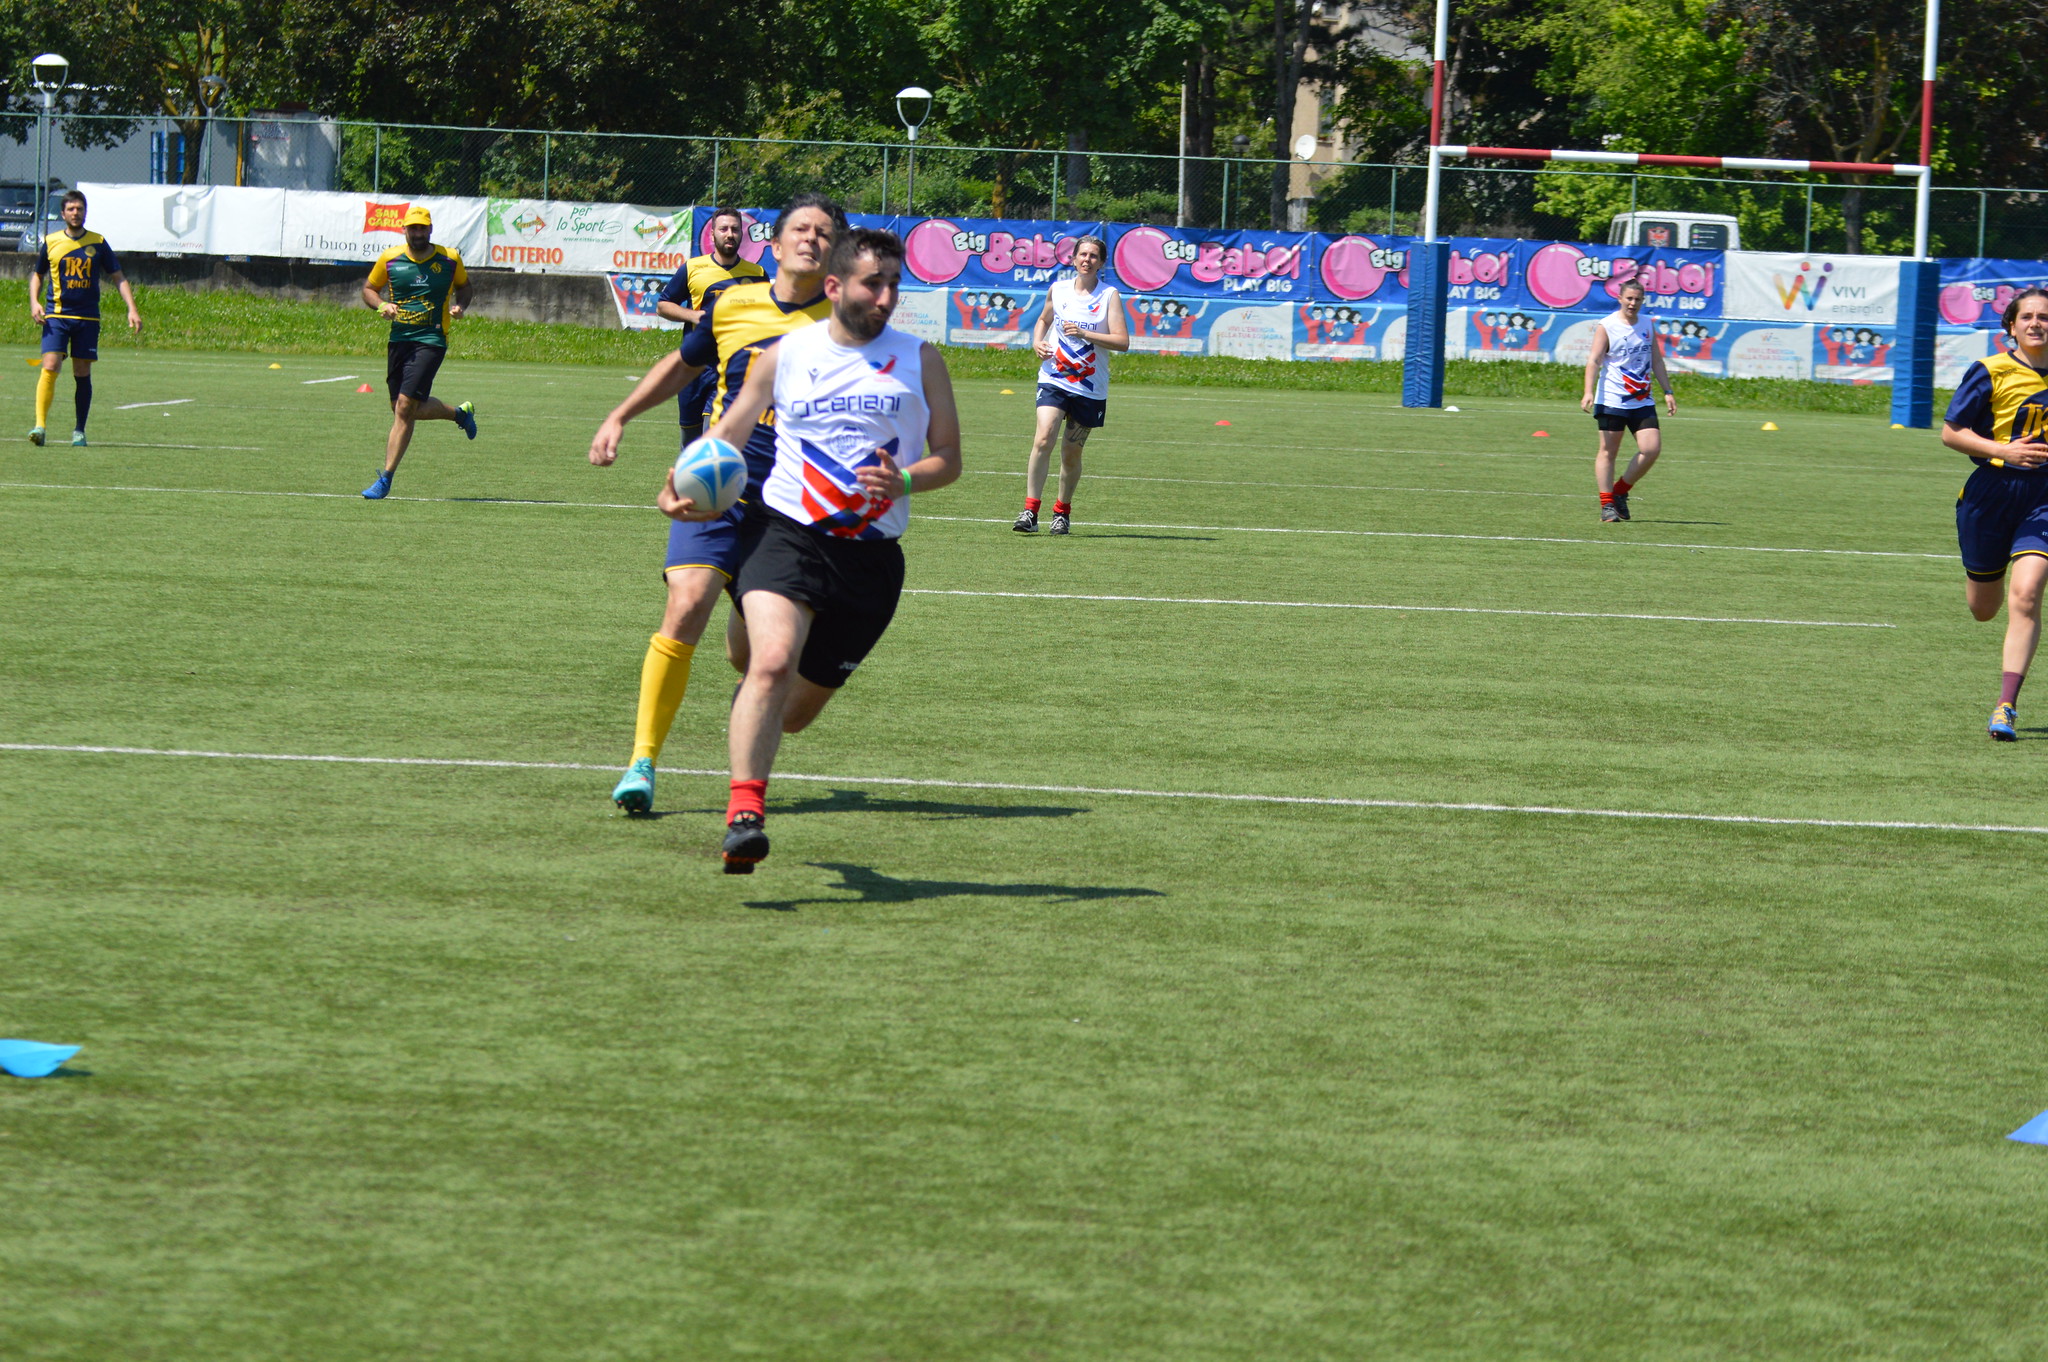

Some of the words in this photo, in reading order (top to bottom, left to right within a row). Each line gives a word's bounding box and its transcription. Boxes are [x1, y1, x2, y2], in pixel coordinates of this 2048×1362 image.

[375, 208, 399, 219] SAN
[570, 206, 593, 219] per
[368, 217, 404, 228] CARLO
[556, 216, 569, 231] lo
[571, 217, 605, 235] Sport
[320, 235, 357, 250] buon
[491, 245, 564, 265] CITTERIO
[613, 250, 685, 269] CITTERIO
[952, 231, 987, 253] Big
[981, 232, 1077, 273] Babo
[1369, 247, 1405, 269] Big
[62, 256, 92, 279] TRA
[1162, 239, 1197, 261] Big
[1190, 241, 1301, 283] Babol
[1014, 269, 1053, 282] PLAY
[1576, 256, 1611, 278] Big
[1604, 258, 1715, 299] Babol
[1223, 277, 1262, 291] PLAY
[1266, 279, 1292, 293] BIG
[1832, 286, 1866, 299] VIVI
[1473, 286, 1501, 300] BIG
[1972, 286, 1995, 301] Big
[1678, 297, 1707, 310] BIG
[1832, 303, 1884, 317] energia
